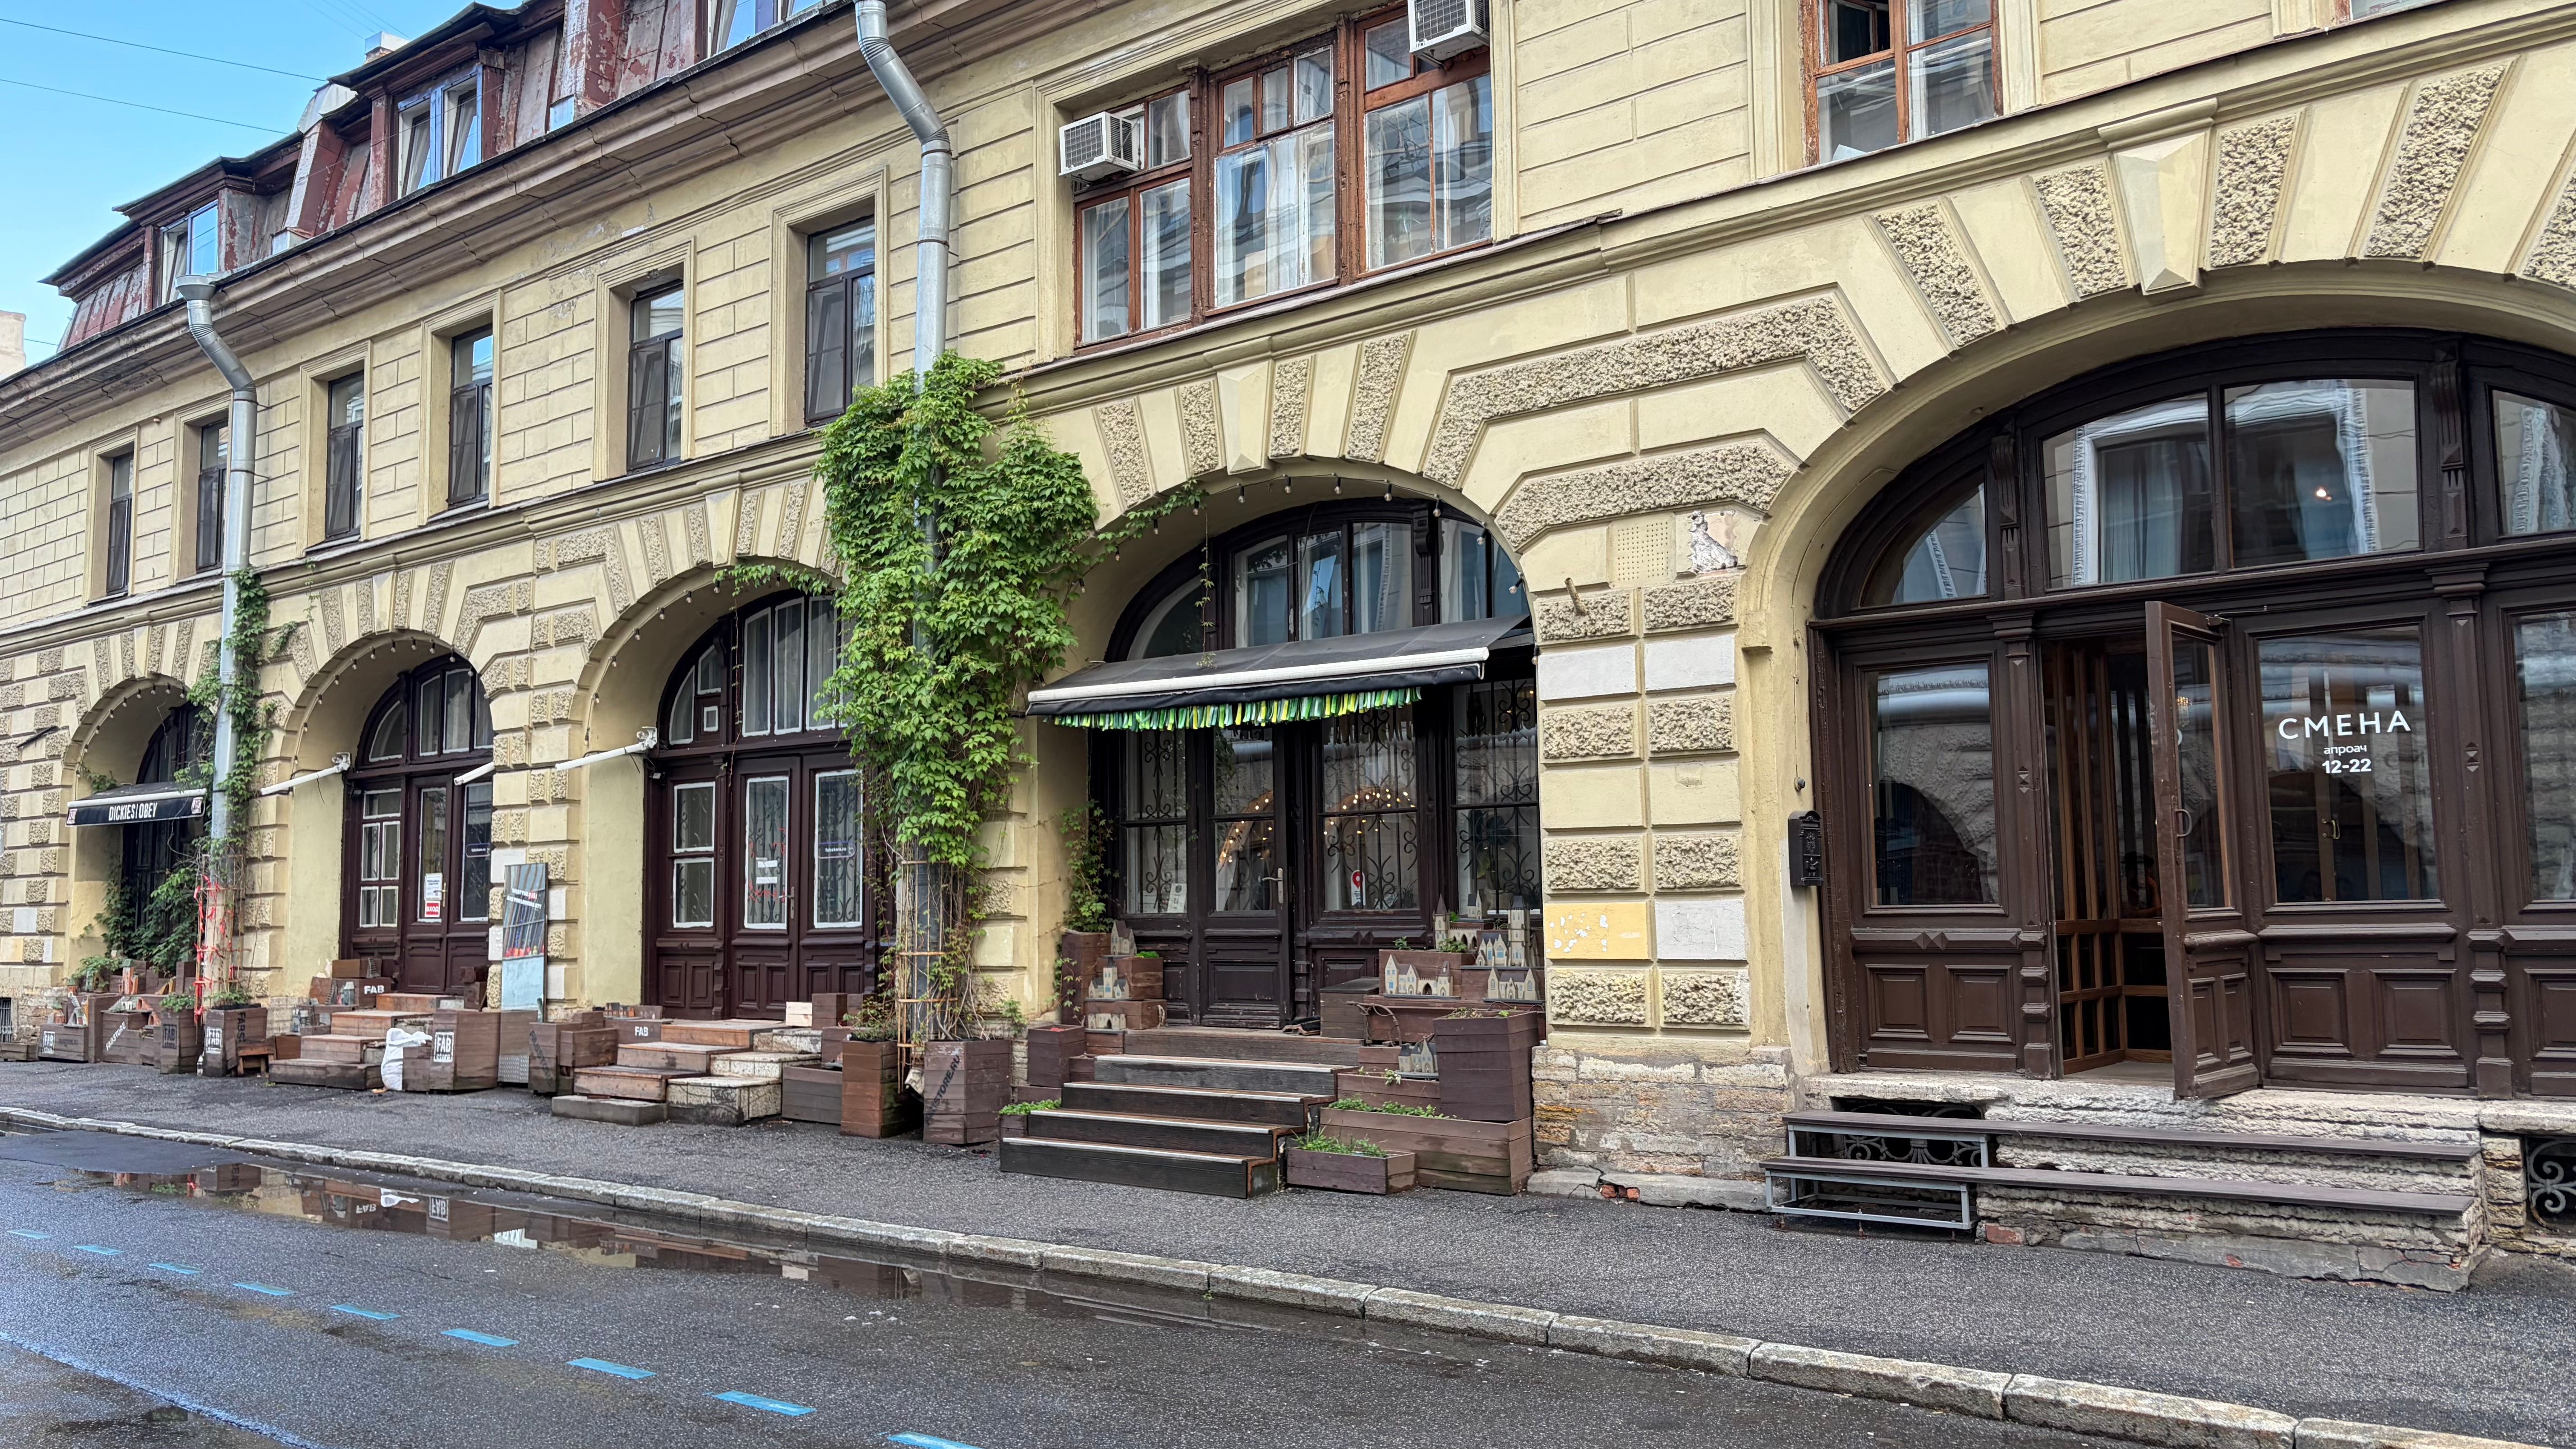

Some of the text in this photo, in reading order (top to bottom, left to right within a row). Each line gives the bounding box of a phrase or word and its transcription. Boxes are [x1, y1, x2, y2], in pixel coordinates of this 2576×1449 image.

[2278, 710, 2411, 739] СМЕНА
[2323, 745, 2367, 756] апроач
[2322, 758, 2372, 774] 12-22
[108, 804, 135, 821] DICKIES
[138, 802, 158, 819] OBEY
[364, 985, 385, 994] FAB
[164, 1028, 175, 1041] FAB
[635, 1026, 649, 1036] FAB
[437, 1036, 451, 1053] FAB
[925, 1054, 961, 1122] STORE.RU
